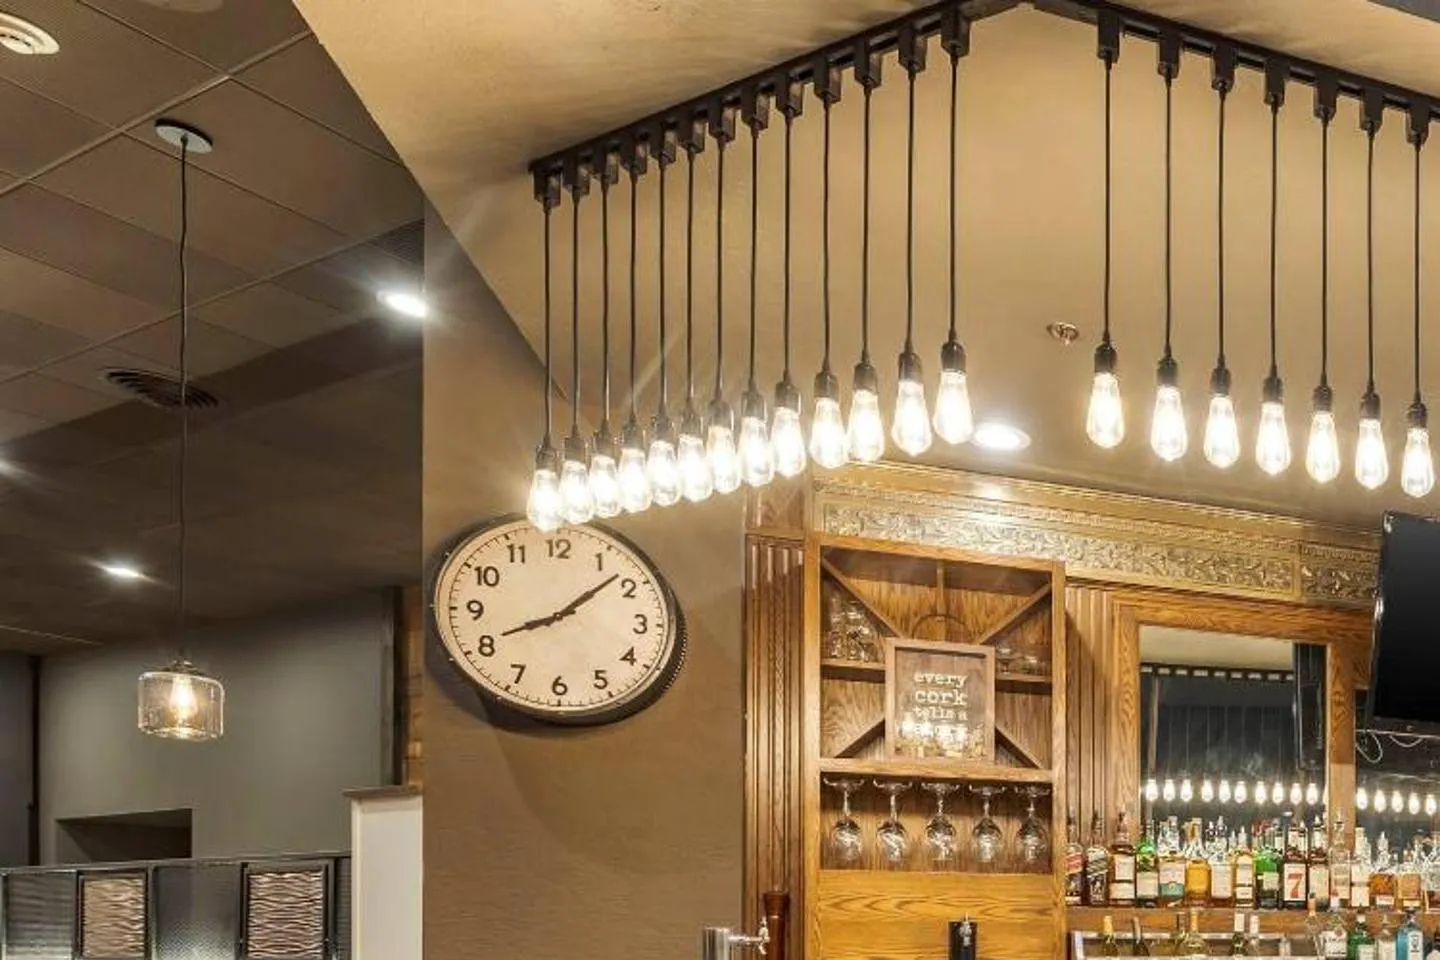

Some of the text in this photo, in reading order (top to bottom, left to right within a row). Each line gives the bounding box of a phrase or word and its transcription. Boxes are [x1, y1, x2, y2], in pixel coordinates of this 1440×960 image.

[507, 544, 526, 563] 11
[546, 539, 571, 559] 12
[595, 553, 603, 571] 1
[474, 566, 500, 587] 10
[620, 578, 637, 599] 2
[466, 600, 484, 621] 9
[632, 614, 648, 634] 3
[478, 635, 495, 657] 8
[620, 647, 637, 665] 4
[510, 664, 526, 684] 7
[593, 670, 608, 689] 5
[914, 672, 968, 688] every
[551, 676, 568, 696] 6
[915, 689, 968, 706] cork
[1288, 873, 1304, 899] 7
